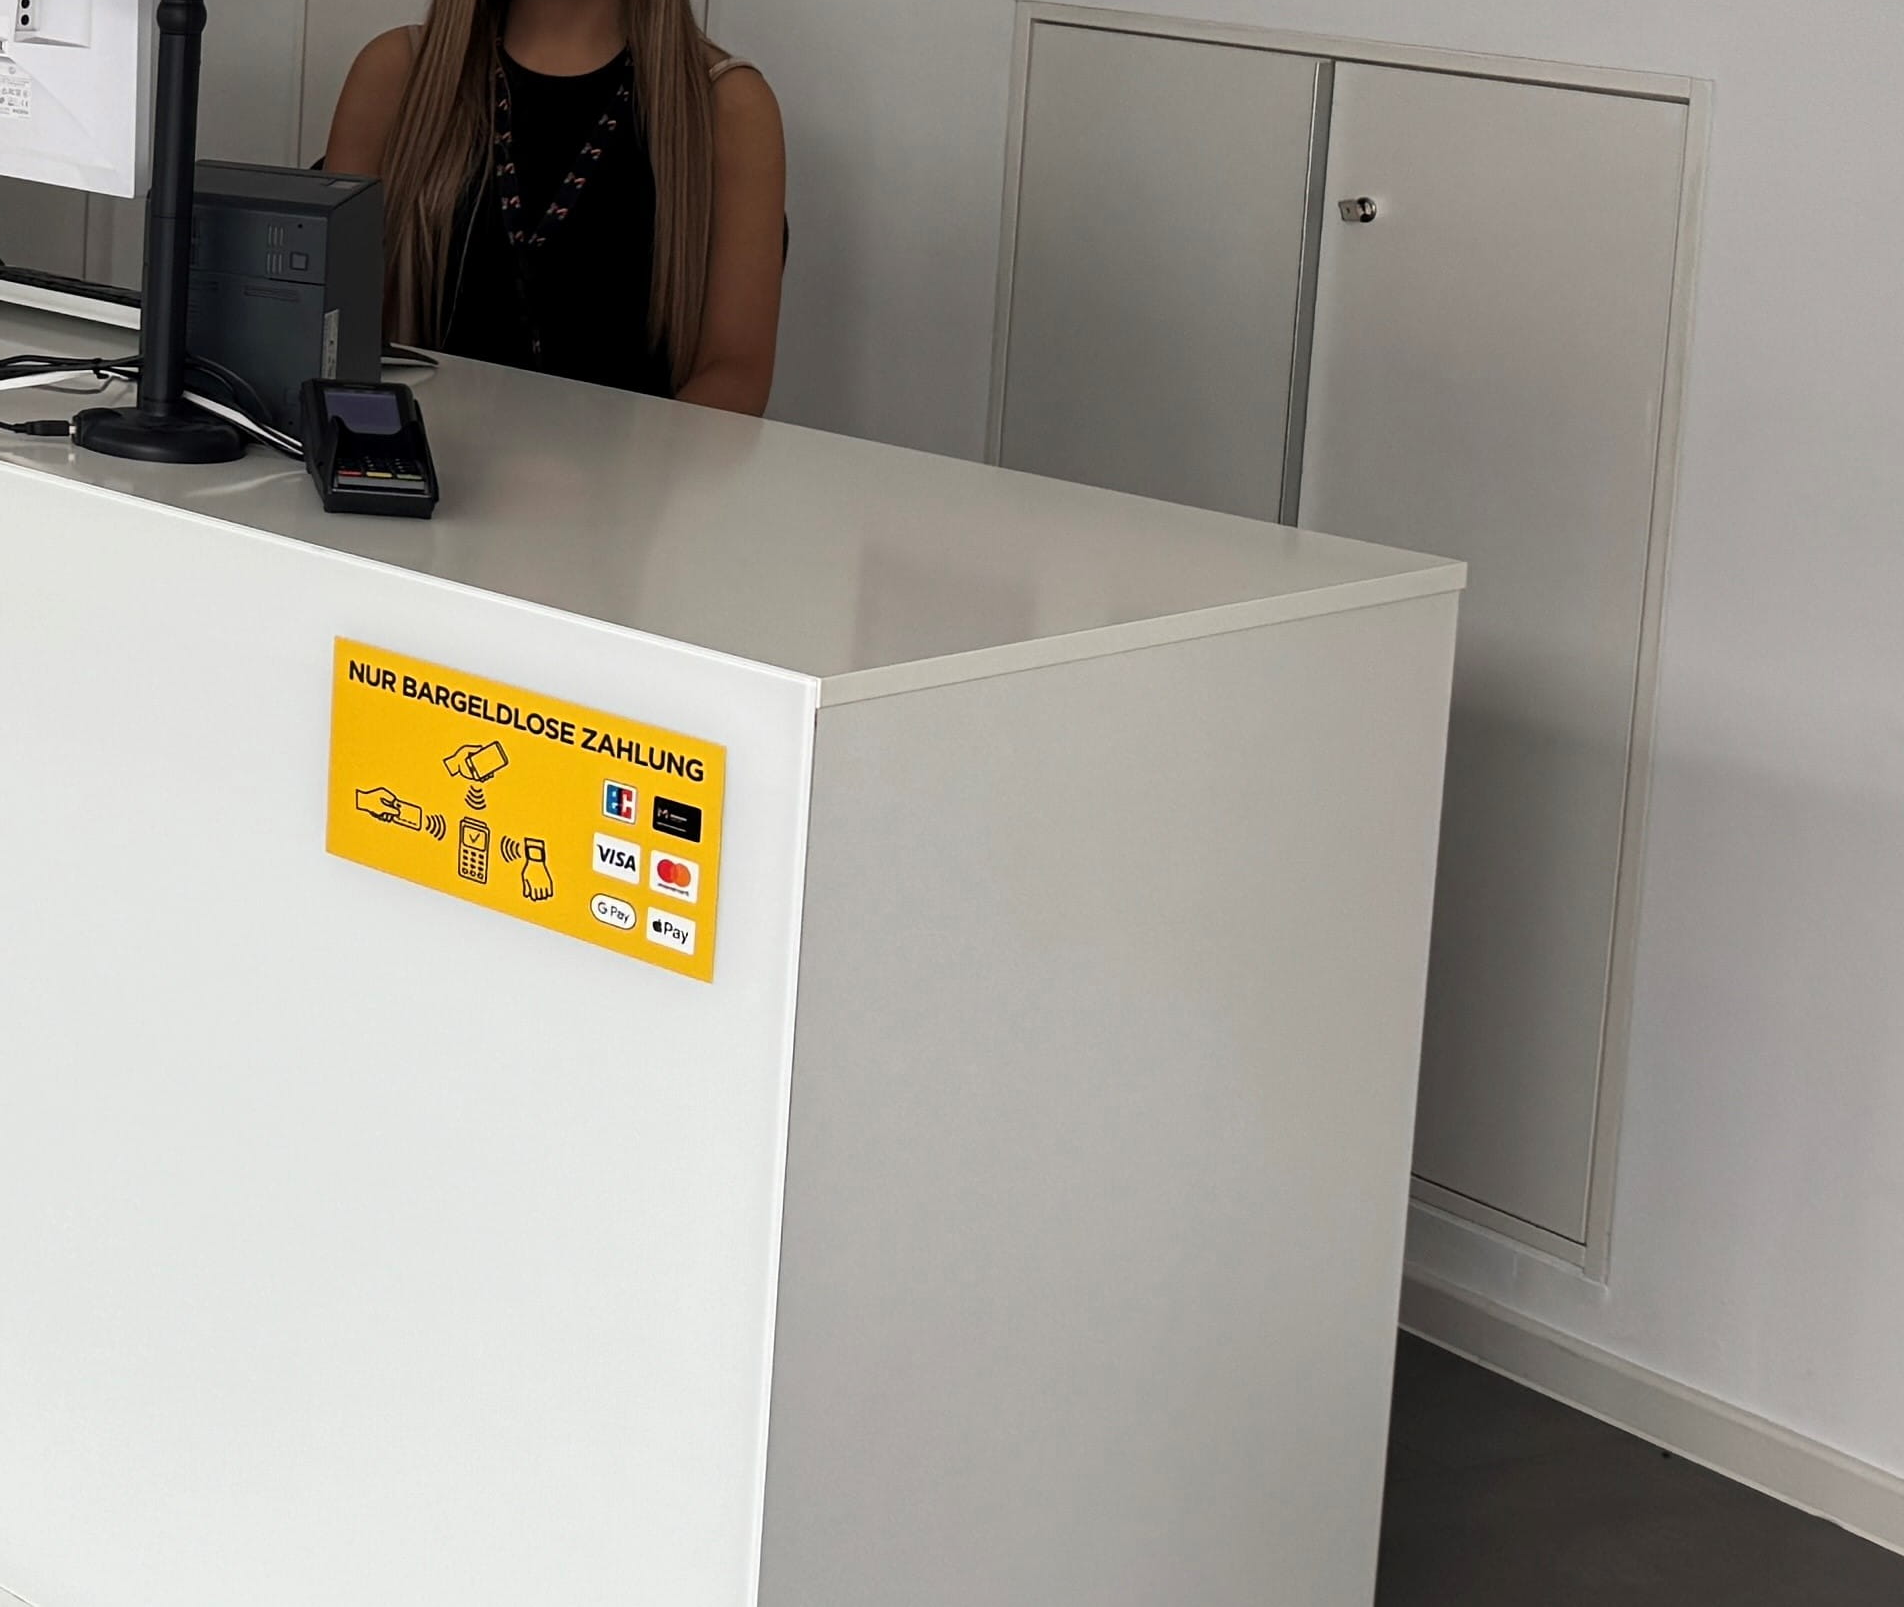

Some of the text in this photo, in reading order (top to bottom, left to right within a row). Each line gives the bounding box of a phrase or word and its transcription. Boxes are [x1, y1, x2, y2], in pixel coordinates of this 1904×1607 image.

[349, 659, 705, 782] NUR BARGELDLOSE ZAHLUNG
[596, 844, 636, 872] VISA
